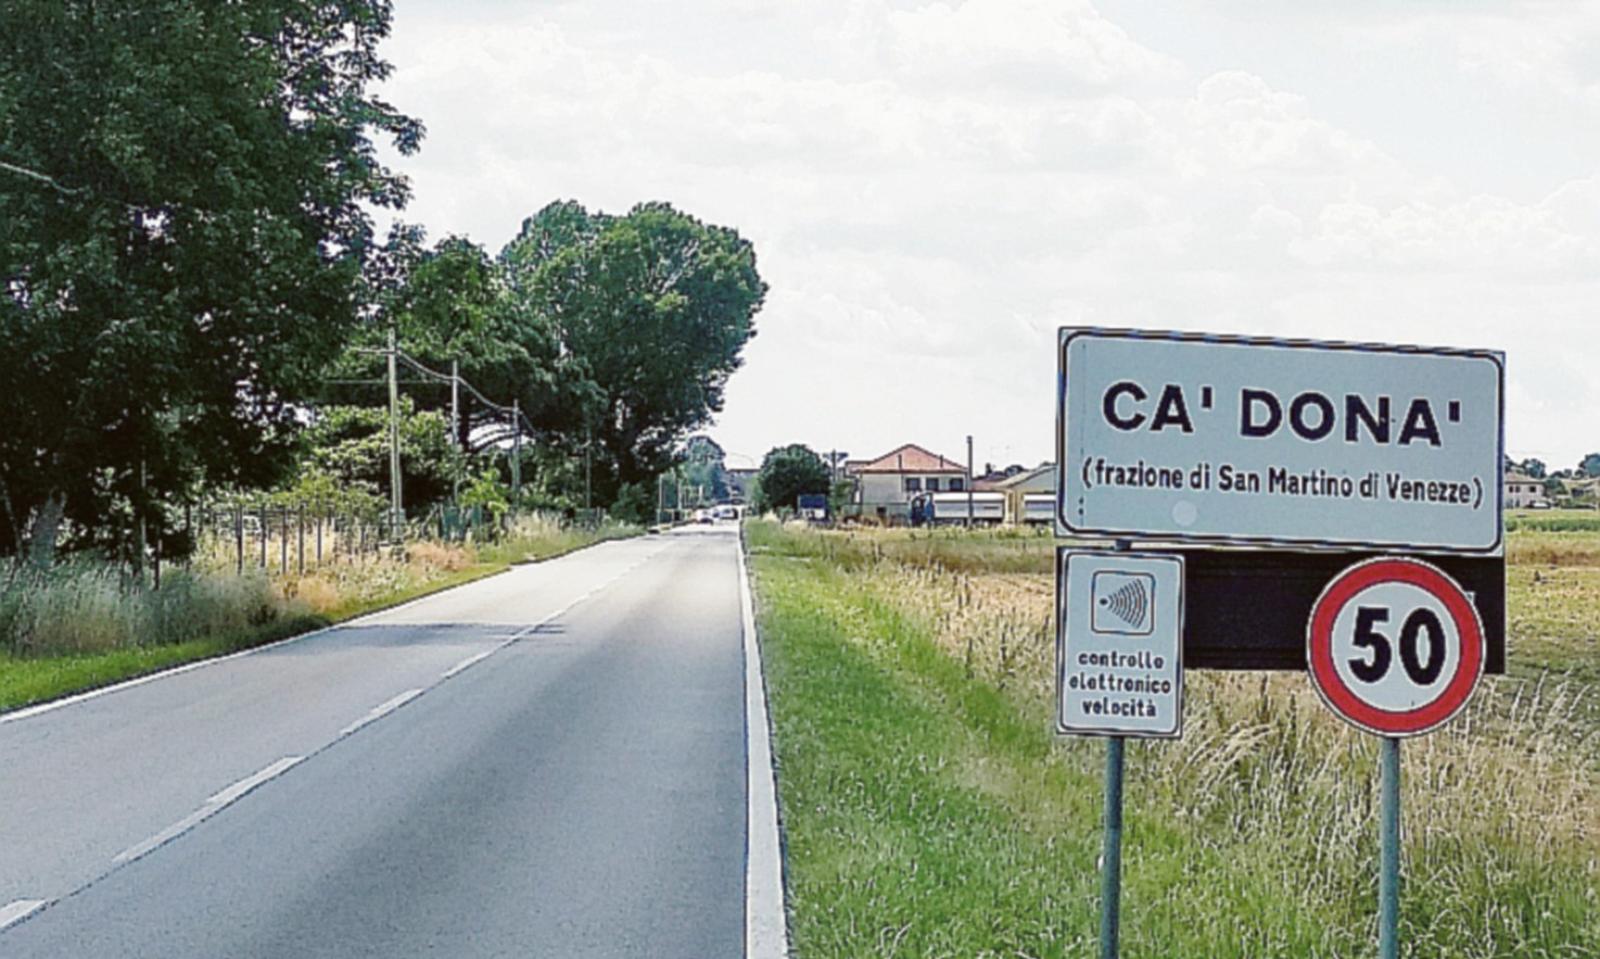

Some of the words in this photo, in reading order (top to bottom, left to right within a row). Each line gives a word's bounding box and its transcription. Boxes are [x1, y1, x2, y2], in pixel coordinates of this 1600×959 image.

[1103, 381, 1212, 433] CA'
[1240, 388, 1461, 447] DONA'
[1082, 457, 1184, 489] (frazione
[1190, 463, 1211, 489] di
[1219, 464, 1260, 493] San
[1268, 467, 1353, 498] Martino
[1360, 471, 1379, 498] di
[1386, 473, 1484, 510] Venezze)
[1078, 651, 1165, 670] controllo
[1347, 606, 1447, 686] 50
[1068, 673, 1172, 695] elettronico
[1082, 698, 1157, 718] velocità
